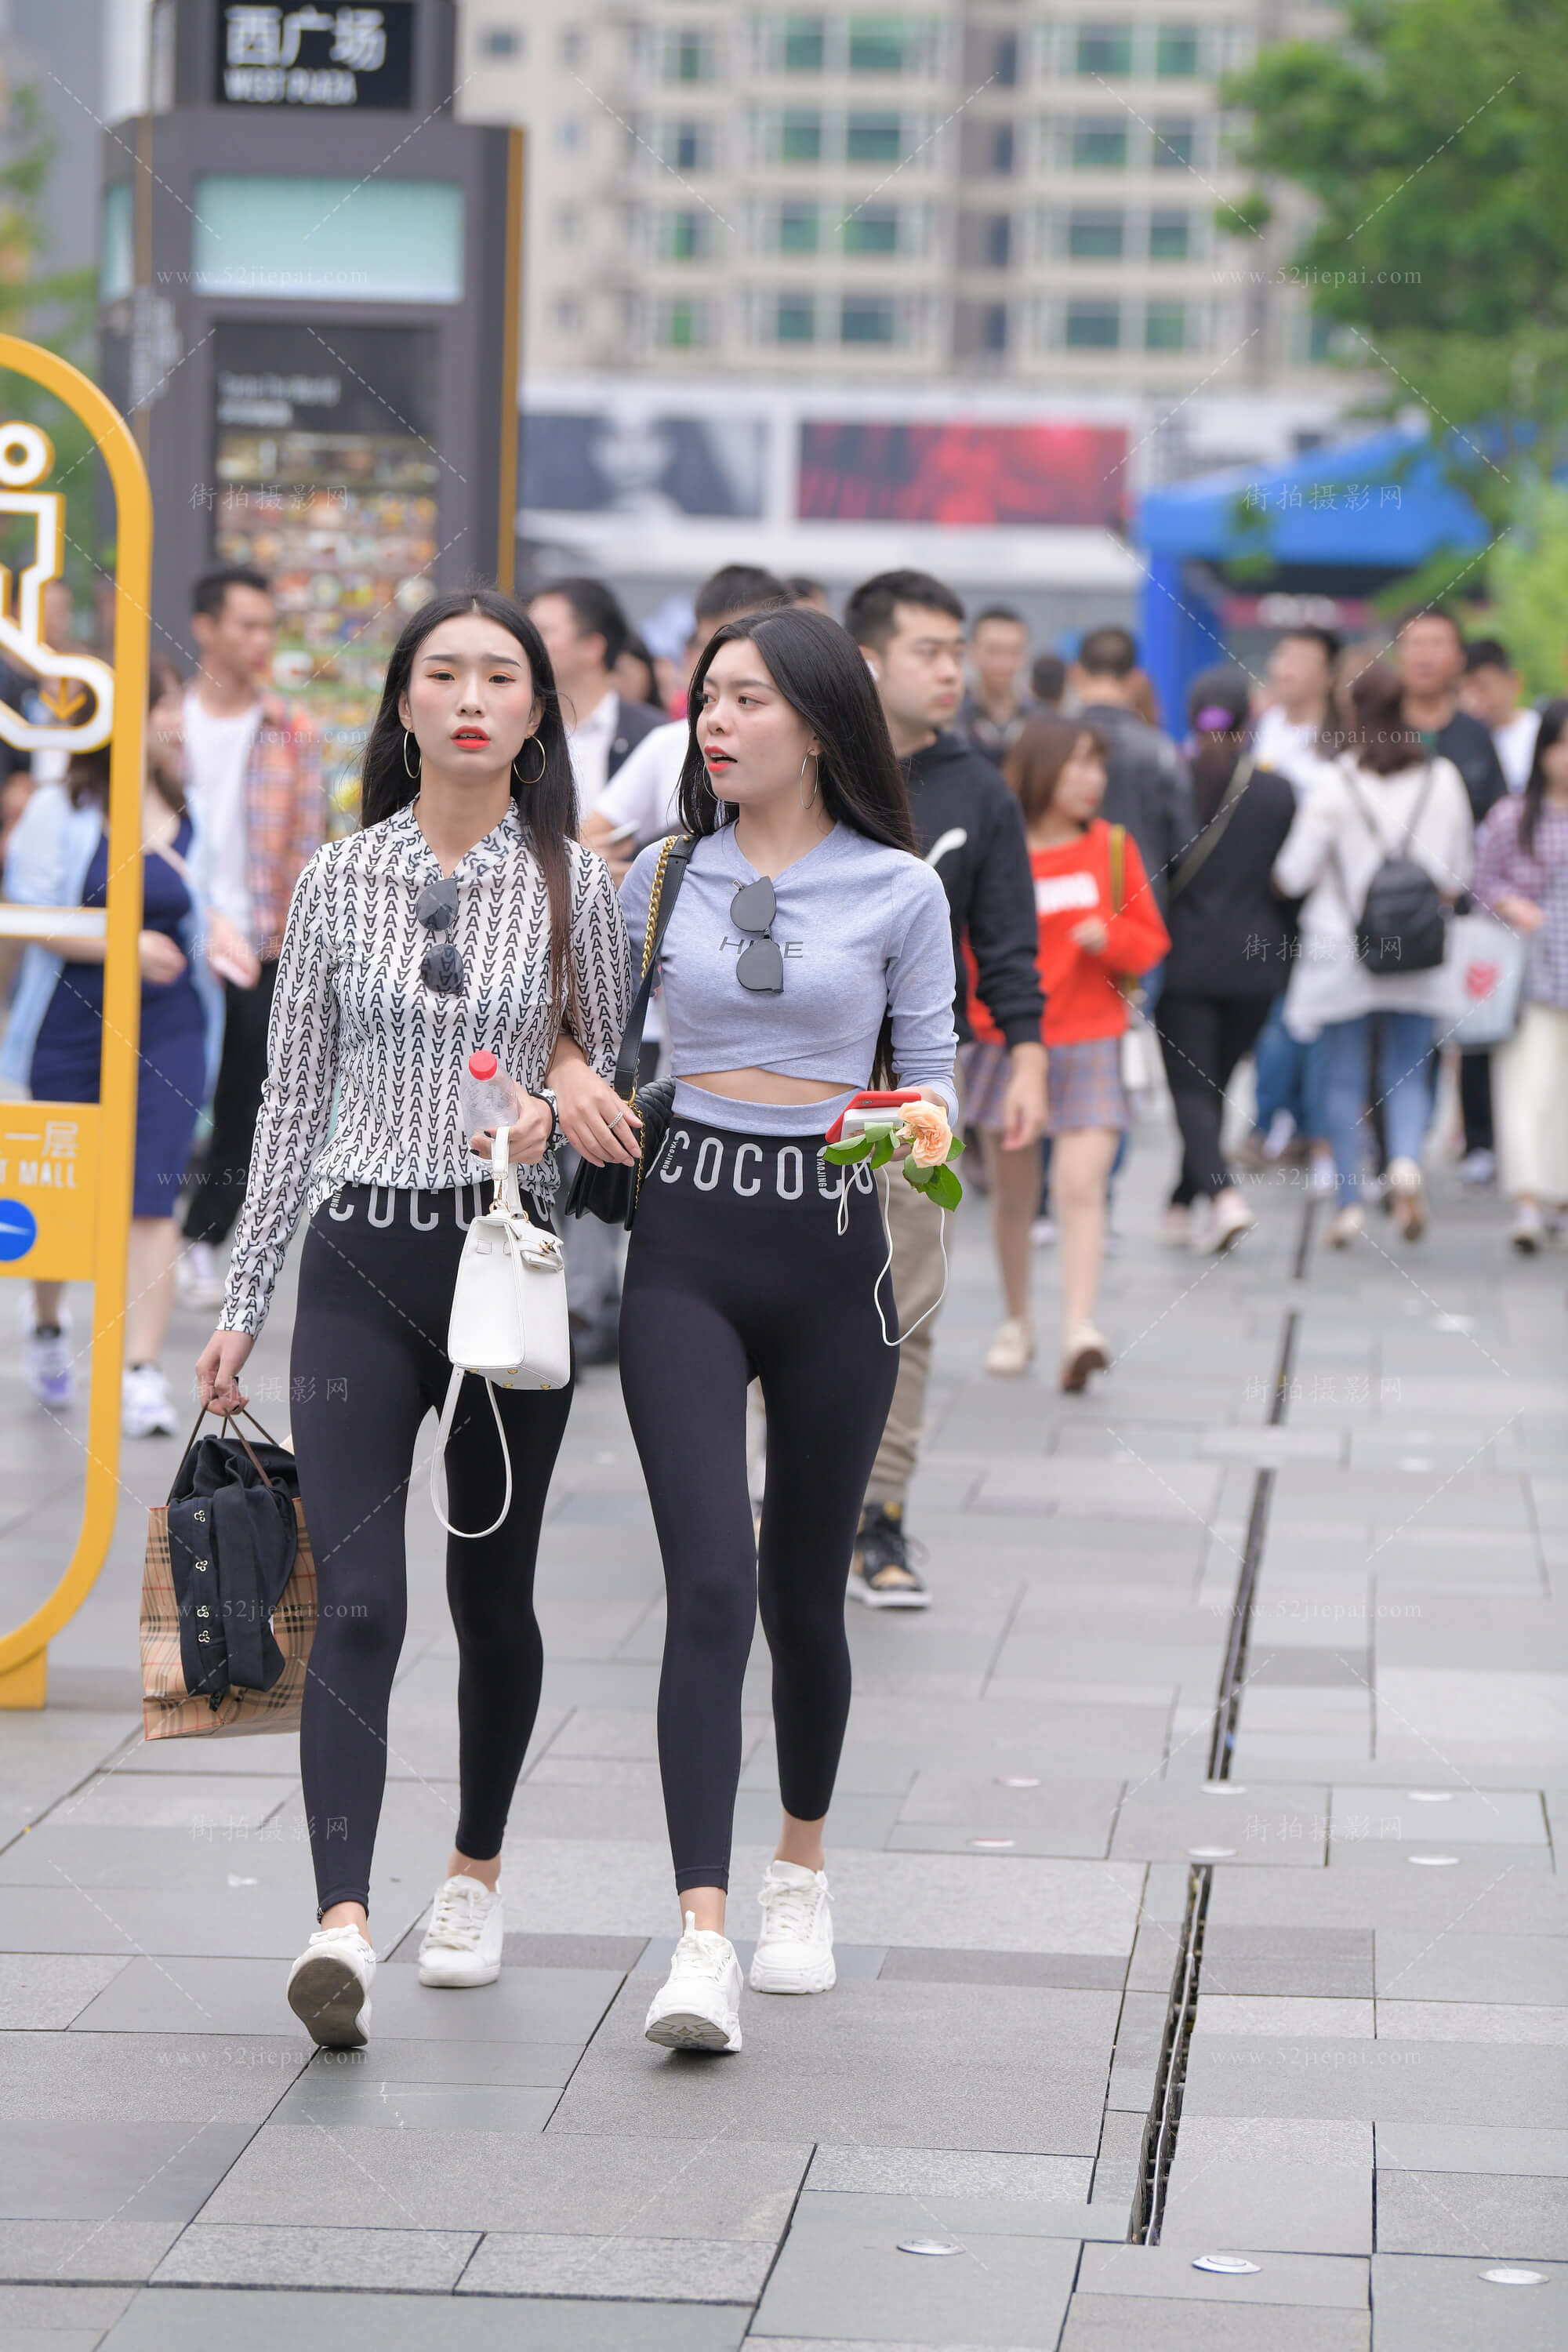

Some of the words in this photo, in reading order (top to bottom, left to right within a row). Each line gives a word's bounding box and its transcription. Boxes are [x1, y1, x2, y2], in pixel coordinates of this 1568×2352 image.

[224, 4, 387, 71] 西广场
[0, 1120, 79, 1158] 一层
[662, 1141, 679, 1169] YAOJING
[18, 1160, 77, 1189] MALL
